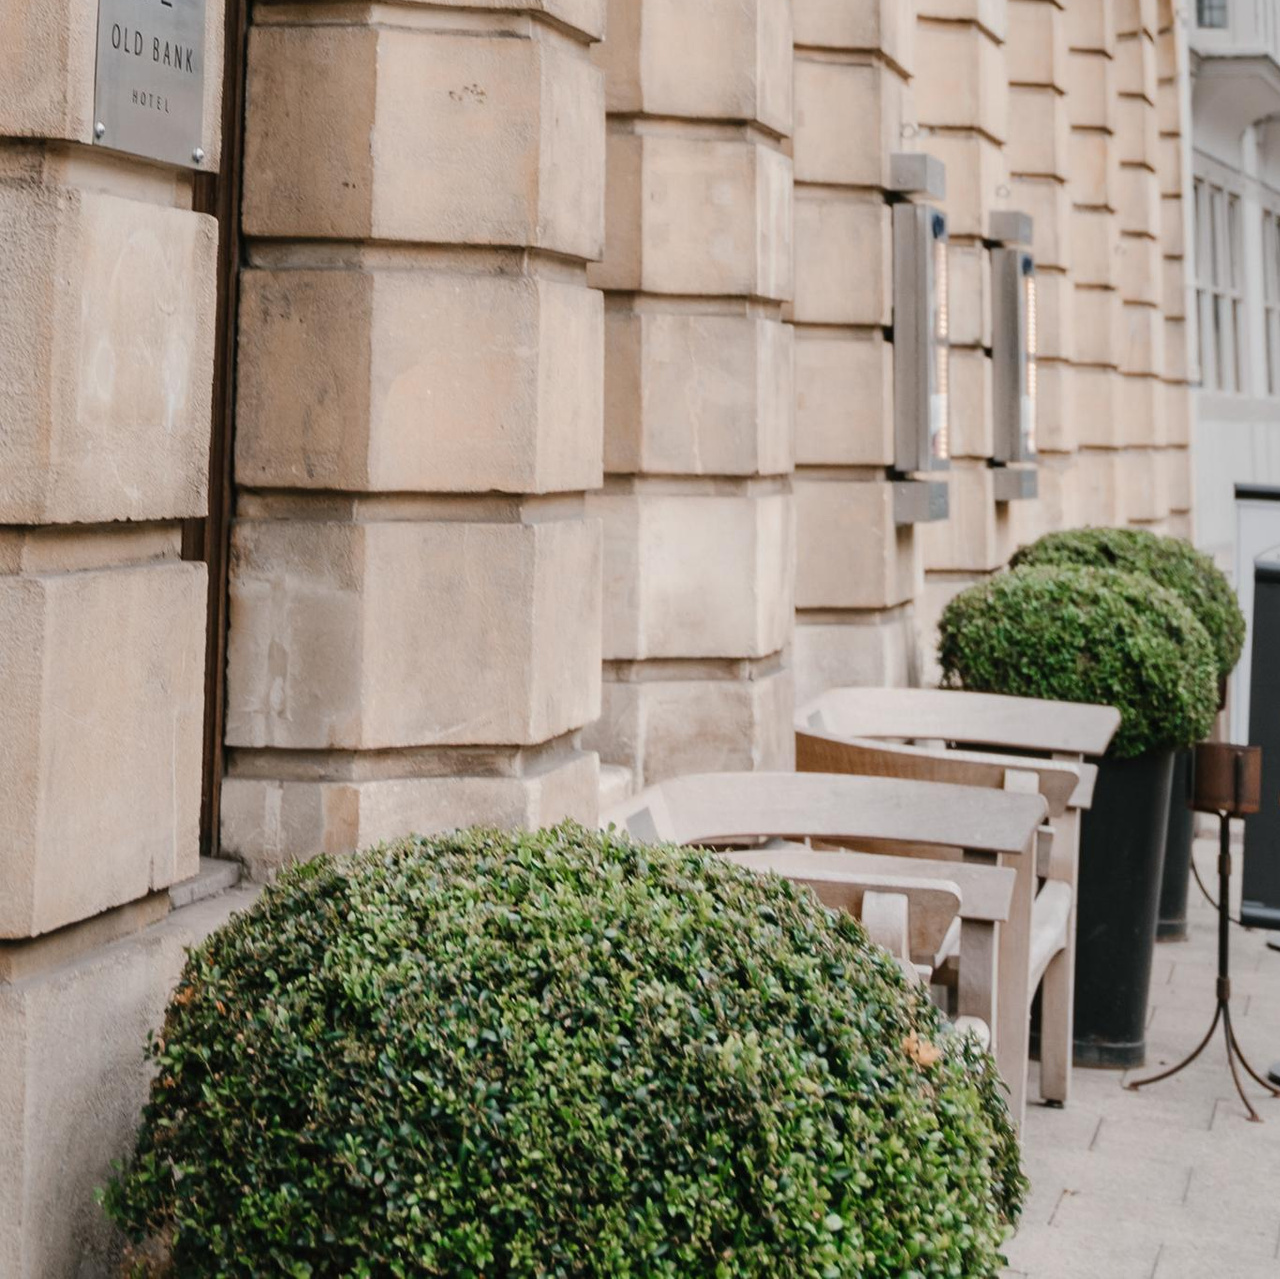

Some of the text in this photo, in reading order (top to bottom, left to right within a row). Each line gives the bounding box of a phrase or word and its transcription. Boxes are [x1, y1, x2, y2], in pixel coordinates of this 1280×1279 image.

[111, 23, 194, 74] OLD BANK
[132, 88, 171, 115] HOTEL
